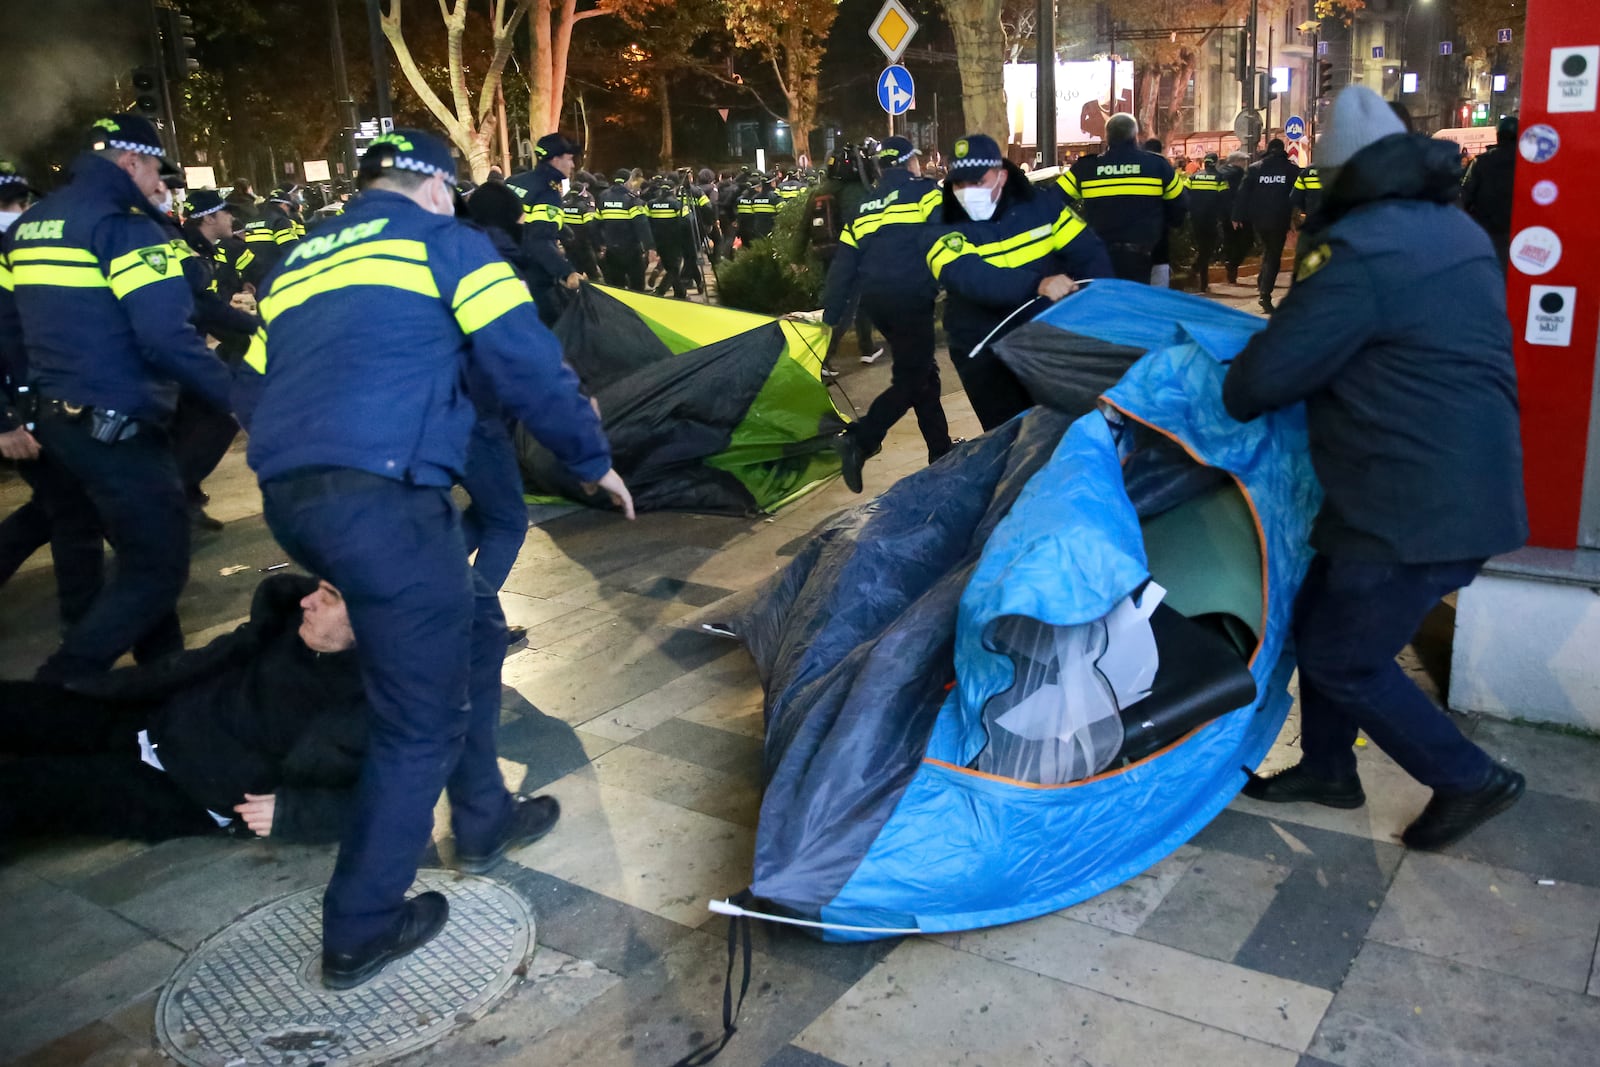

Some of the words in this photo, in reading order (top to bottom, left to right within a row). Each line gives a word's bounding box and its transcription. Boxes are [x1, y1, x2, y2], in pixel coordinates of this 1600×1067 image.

[1097, 163, 1141, 177] POLICE
[1260, 175, 1286, 184] POLICE
[860, 189, 900, 214] POLICE
[14, 219, 65, 241] POLICE
[284, 216, 390, 268] POLICE
